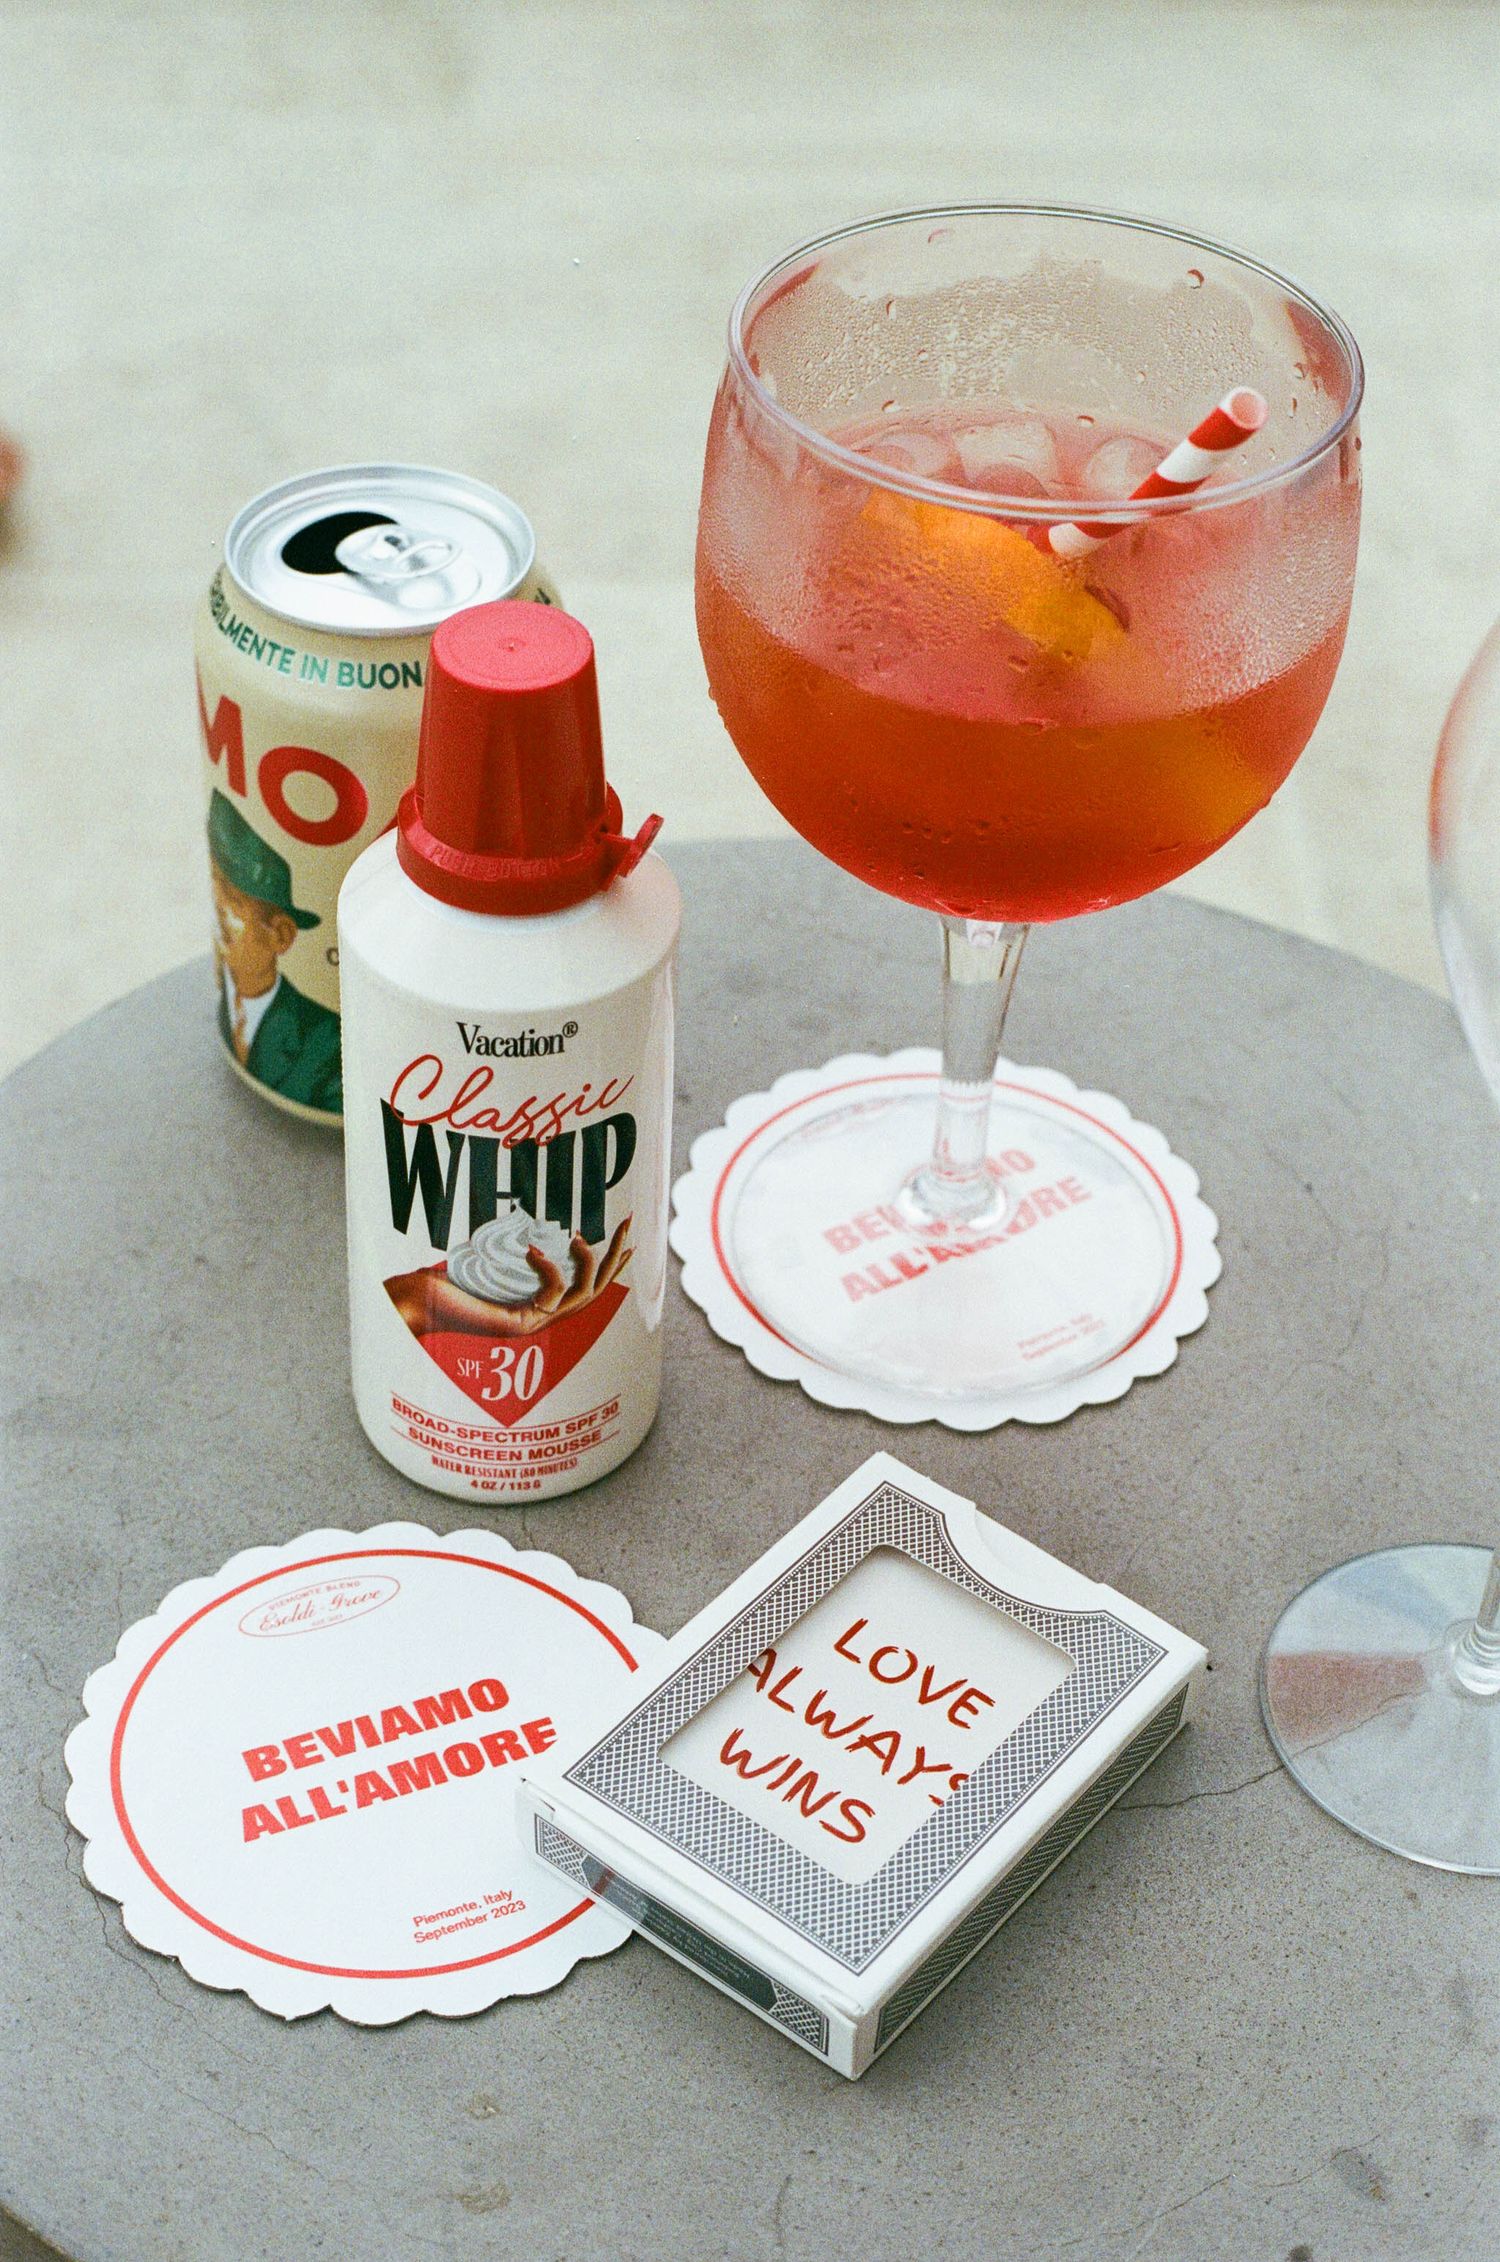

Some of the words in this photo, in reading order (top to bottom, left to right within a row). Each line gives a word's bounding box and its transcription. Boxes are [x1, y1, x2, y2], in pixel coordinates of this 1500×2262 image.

[299, 653, 329, 684] IN
[390, 1054, 635, 1150] Classic
[379, 1098, 637, 1252] WHIP
[457, 1357, 484, 1379] SPF
[481, 1344, 545, 1402] 30
[392, 1398, 560, 1443] BROAD-SPECTRUM
[565, 1417, 599, 1435] SPF
[601, 1402, 620, 1420] 30
[408, 1426, 522, 1461] SUNSCREEN
[528, 1430, 602, 1460] MOUSSE
[465, 1465, 518, 1479] RESISTANT
[481, 1480, 497, 1490] OZ
[833, 1617, 996, 1730] LOVE
[240, 1678, 510, 1783] BEVIAMO
[240, 1716, 559, 1843] ALL'AMORE
[719, 1728, 877, 1844] WINS
[412, 1901, 483, 1928] Piemonte,
[483, 1889, 513, 1906] Italy
[414, 1913, 488, 1944] September
[490, 1899, 527, 1919] 2023
